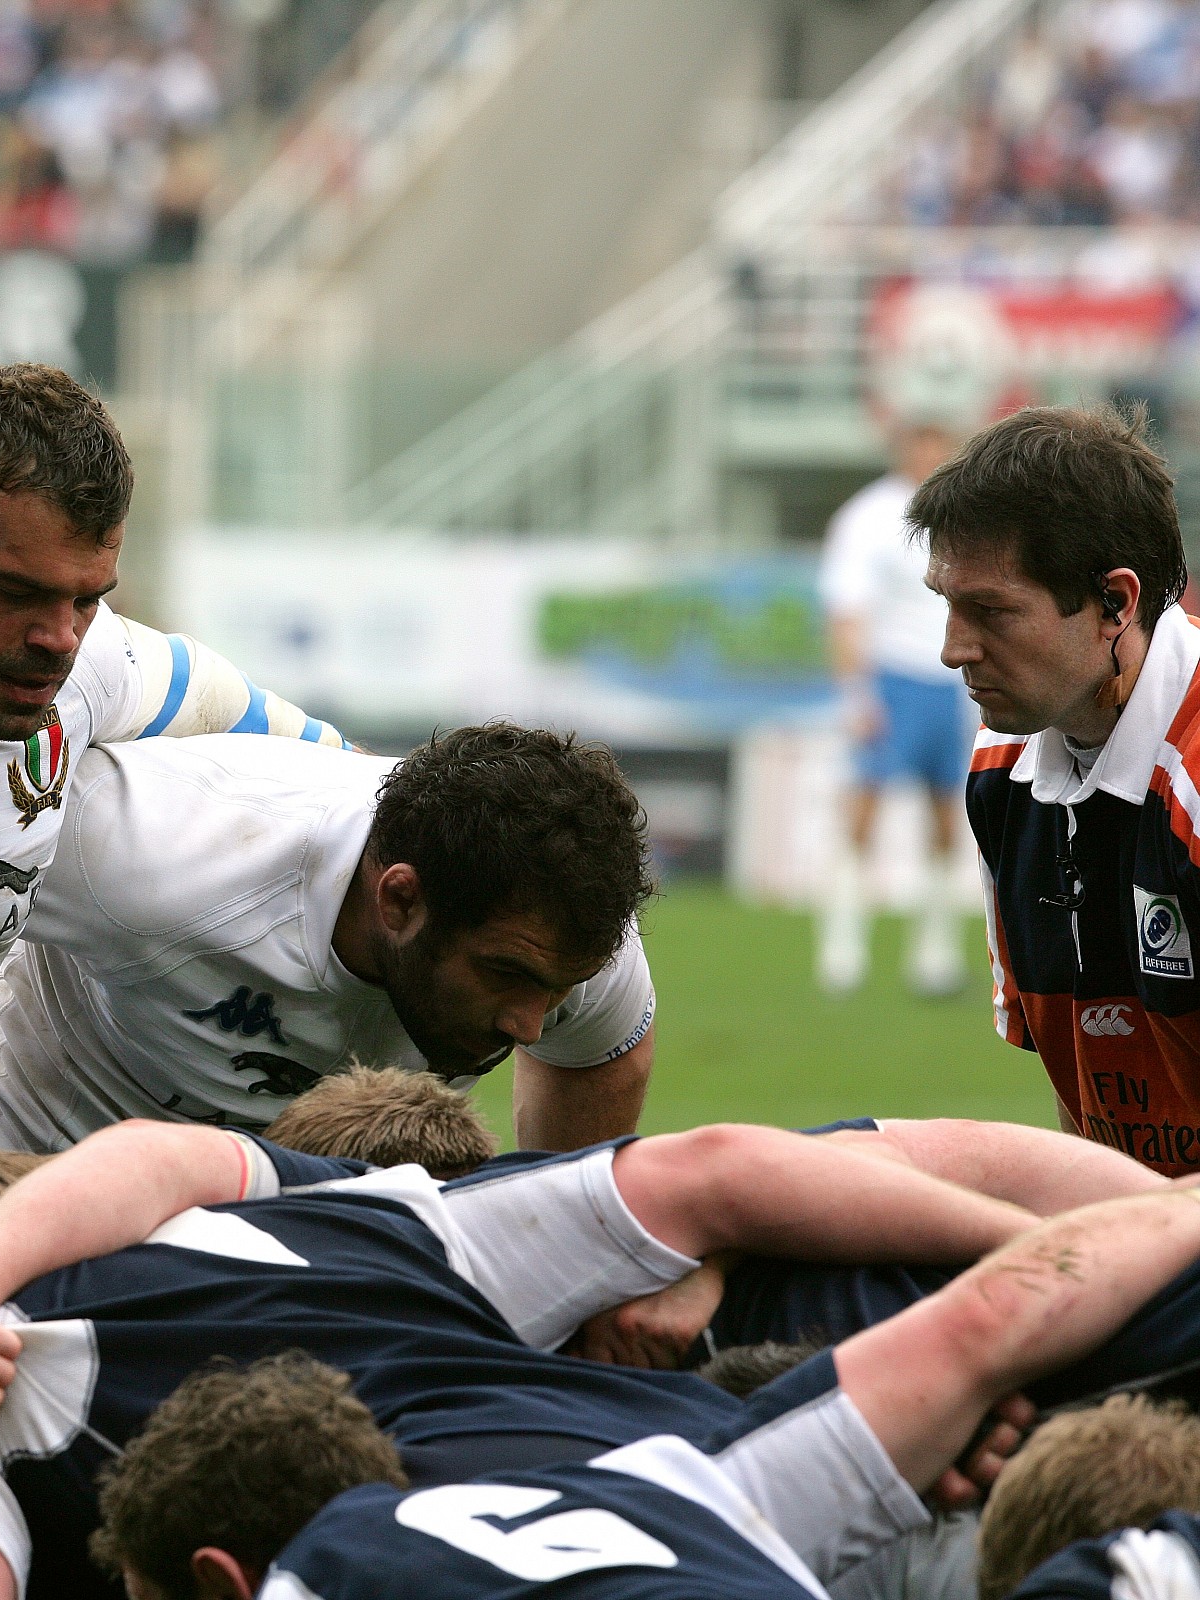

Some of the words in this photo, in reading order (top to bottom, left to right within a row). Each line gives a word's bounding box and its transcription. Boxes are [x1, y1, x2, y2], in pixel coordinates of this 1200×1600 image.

[1145, 956, 1186, 971] REFEREE
[1092, 1072, 1149, 1113] Fly
[1085, 1109, 1200, 1166] mirate
[395, 1484, 678, 1582] 6
